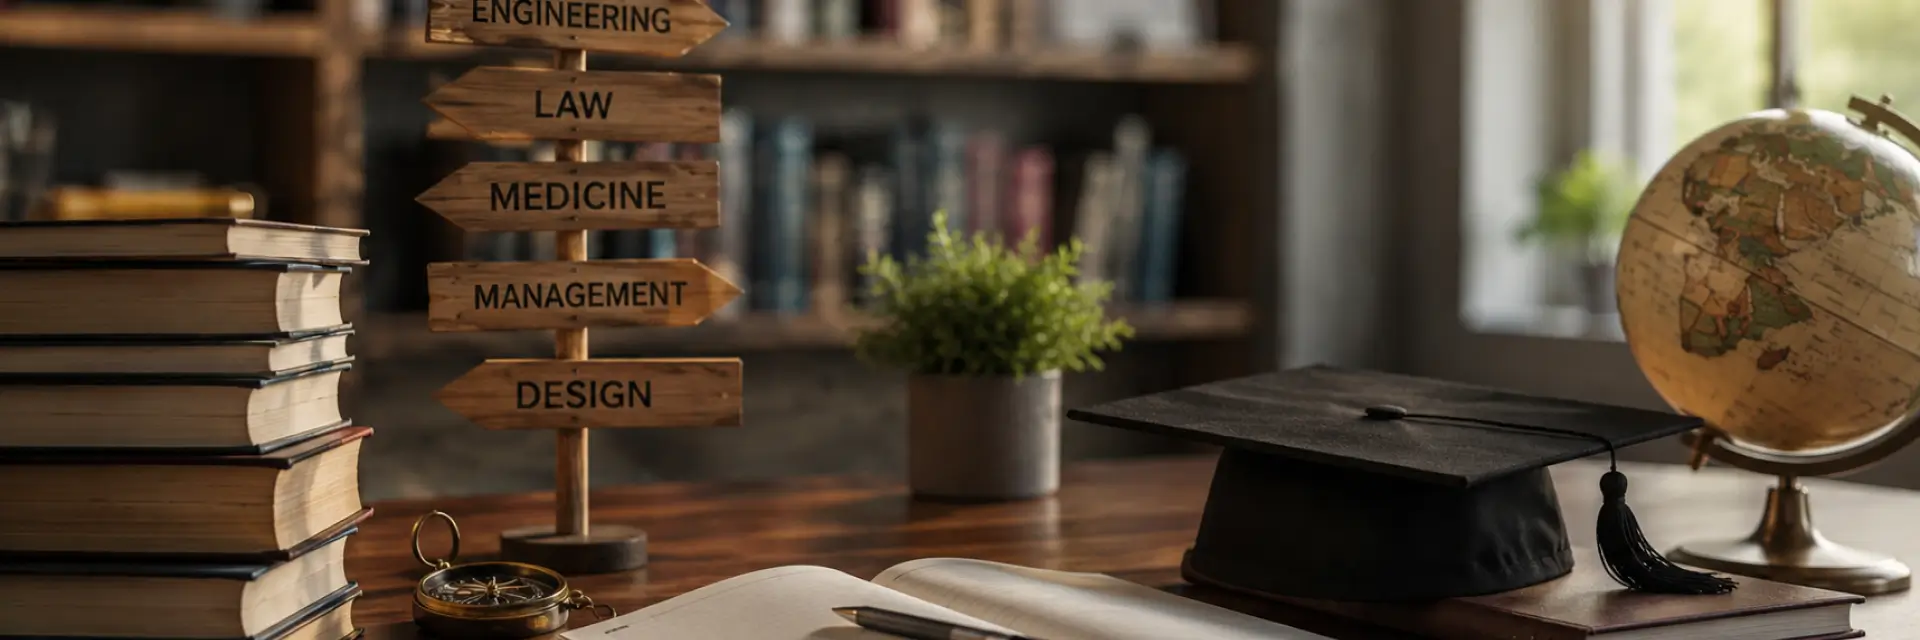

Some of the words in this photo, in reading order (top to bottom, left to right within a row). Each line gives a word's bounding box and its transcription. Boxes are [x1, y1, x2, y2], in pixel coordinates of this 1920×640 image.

[472, 0, 671, 34] ENGINEERING
[535, 90, 613, 119] LAW
[490, 181, 666, 211] MEDICINE
[474, 281, 688, 309] MANAGEMENT
[516, 380, 652, 409] DESIGN
